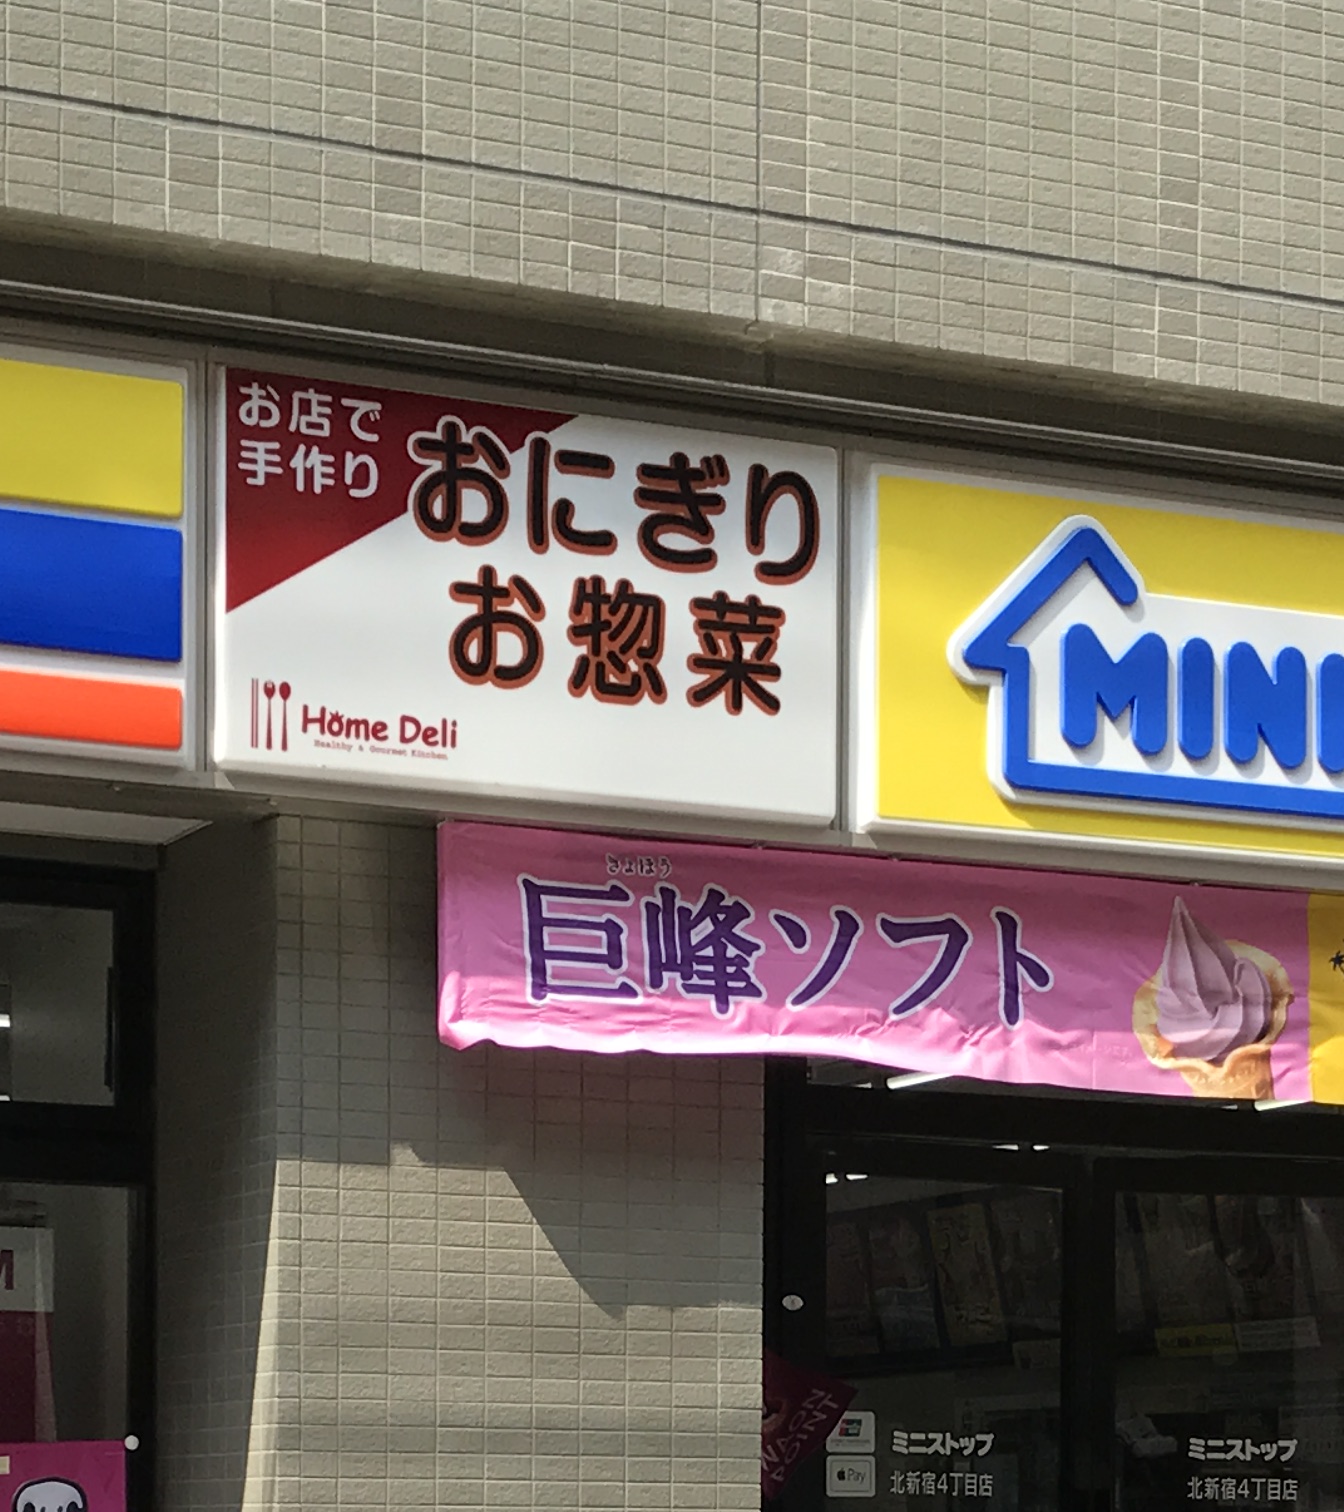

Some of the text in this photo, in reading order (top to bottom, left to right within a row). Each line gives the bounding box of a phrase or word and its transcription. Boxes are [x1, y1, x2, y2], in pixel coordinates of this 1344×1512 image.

[238, 382, 383, 443] お店で
[238, 440, 379, 499] 手作り
[408, 415, 820, 584] おにぎり
[449, 564, 786, 717] お惣菜
[302, 704, 458, 749] Home Deli
[520, 873, 1055, 1031] 巨峰ソフト
[891, 1429, 995, 1457] ミニストップ
[1188, 1437, 1298, 1463] ミニストップ
[890, 1470, 994, 1498] 北新宿4丁目店
[1187, 1475, 1299, 1502] 北新宿4丁目店
